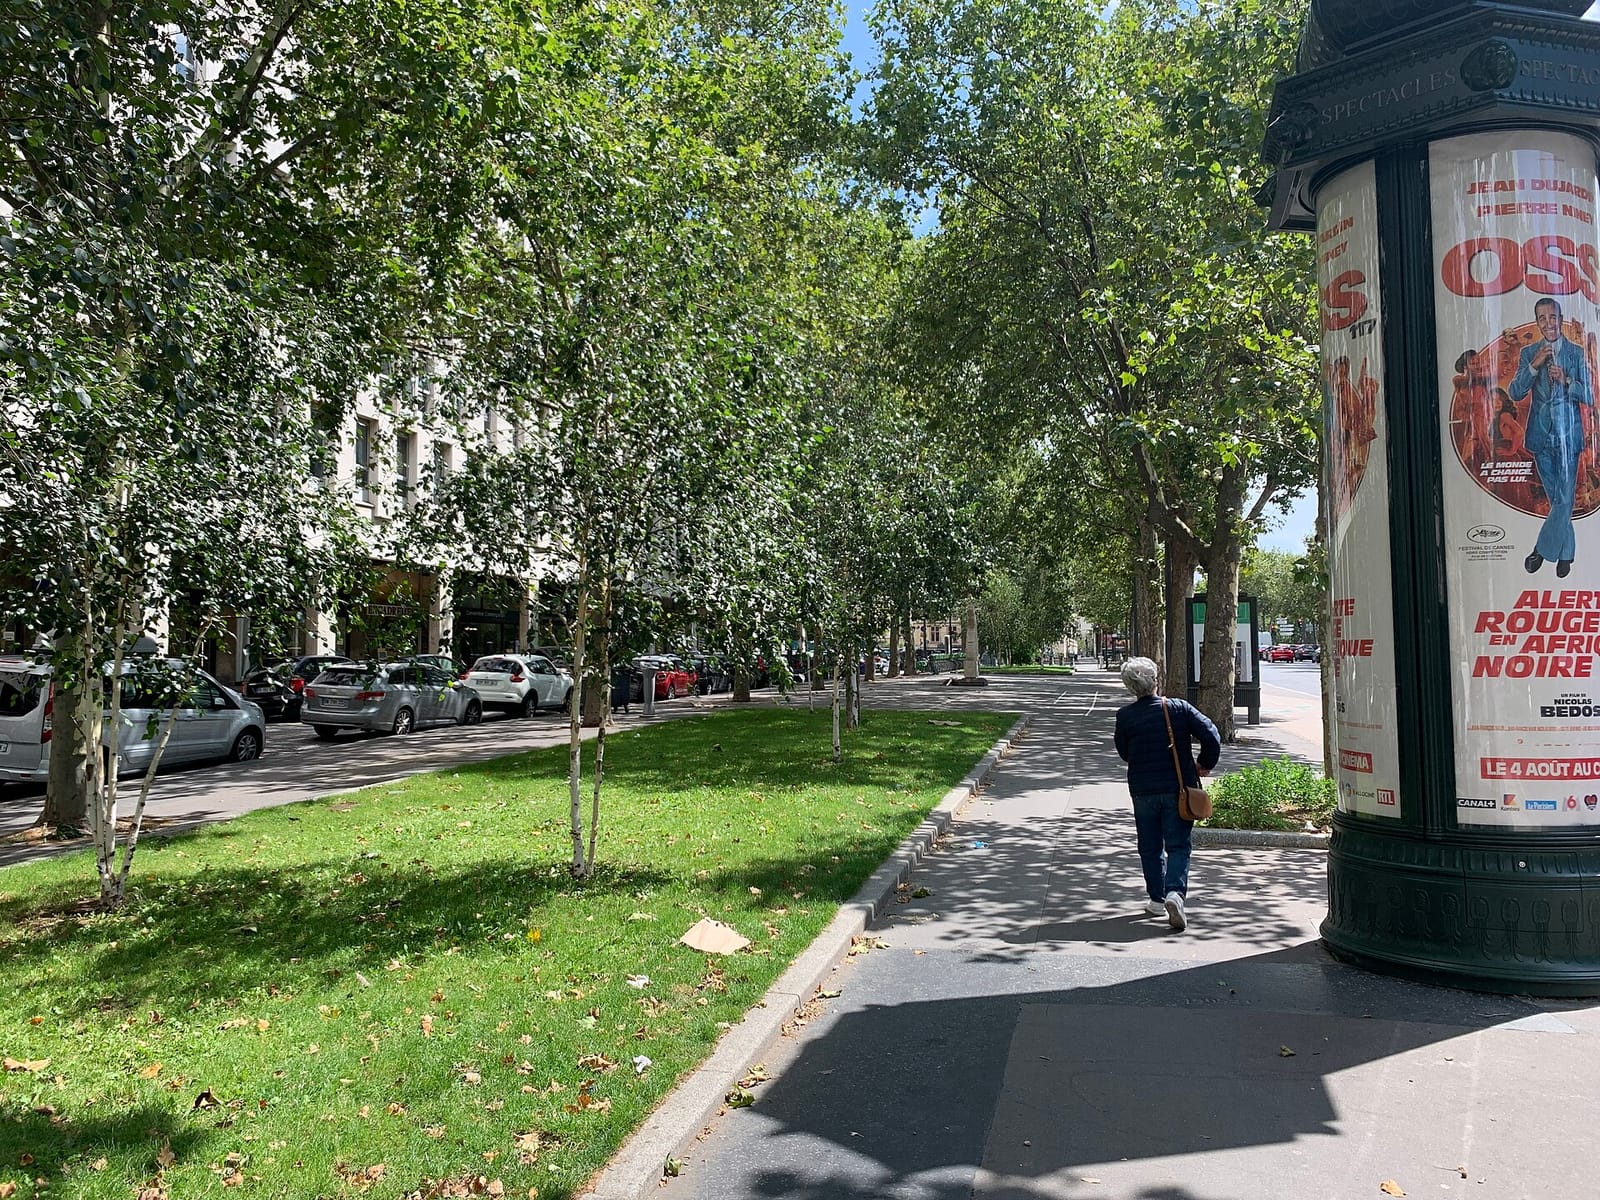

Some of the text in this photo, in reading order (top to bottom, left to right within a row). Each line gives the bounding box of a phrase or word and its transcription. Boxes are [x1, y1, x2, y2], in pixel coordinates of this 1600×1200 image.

[1321, 67, 1457, 125] SPECTACLES
[1466, 179, 1525, 195] JEAN
[1477, 202, 1558, 217] PIERRE
[1441, 235, 1600, 305] OSS
[1474, 611, 1600, 633] ROUGE
[1489, 635, 1517, 645] EN
[1472, 656, 1593, 678] NOIRE
[1540, 705, 1600, 717] BEDOS
[1486, 761, 1507, 775] LE
[1510, 762, 1522, 776] 4
[1525, 760, 1570, 776] AOÛT
[1573, 761, 1591, 776] AU
[1378, 790, 1394, 804] RTL
[1458, 799, 1495, 807] CANAL+
